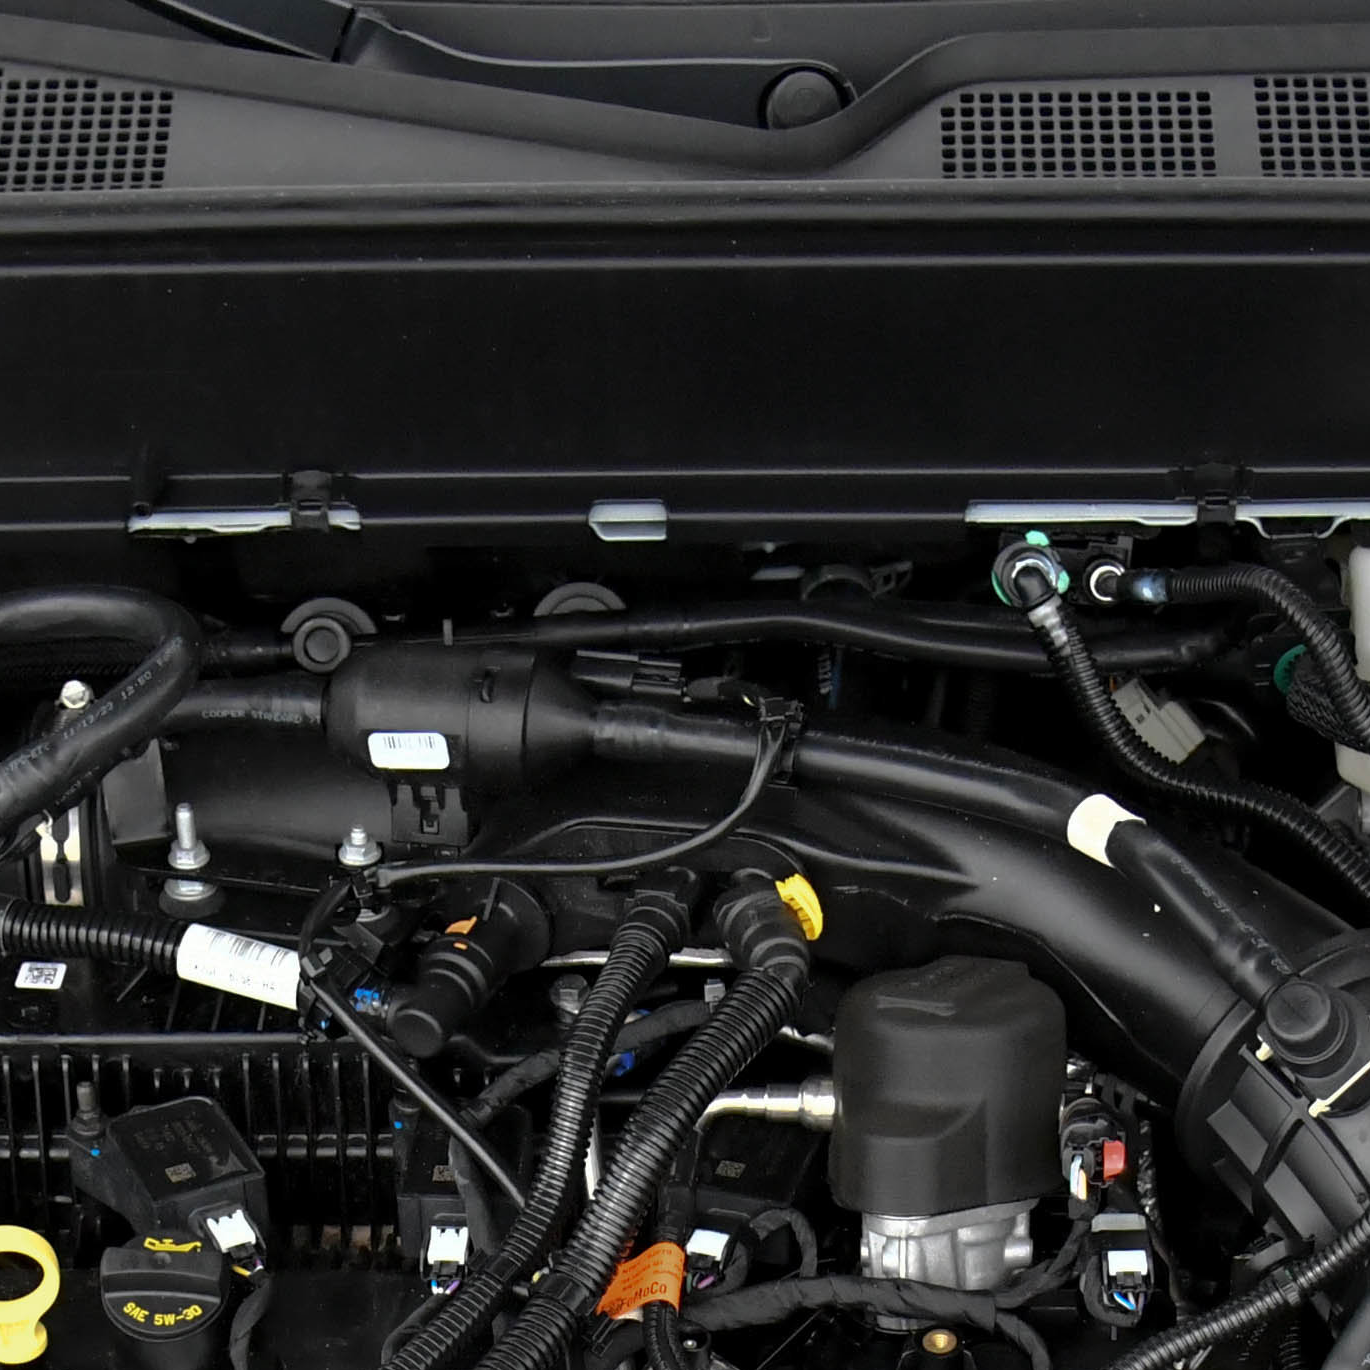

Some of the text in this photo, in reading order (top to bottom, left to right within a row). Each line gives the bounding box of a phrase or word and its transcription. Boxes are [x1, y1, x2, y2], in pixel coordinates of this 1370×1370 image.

[201, 709, 245, 719] COOPER
[123, 1302, 203, 1326] SAE 5W-30
